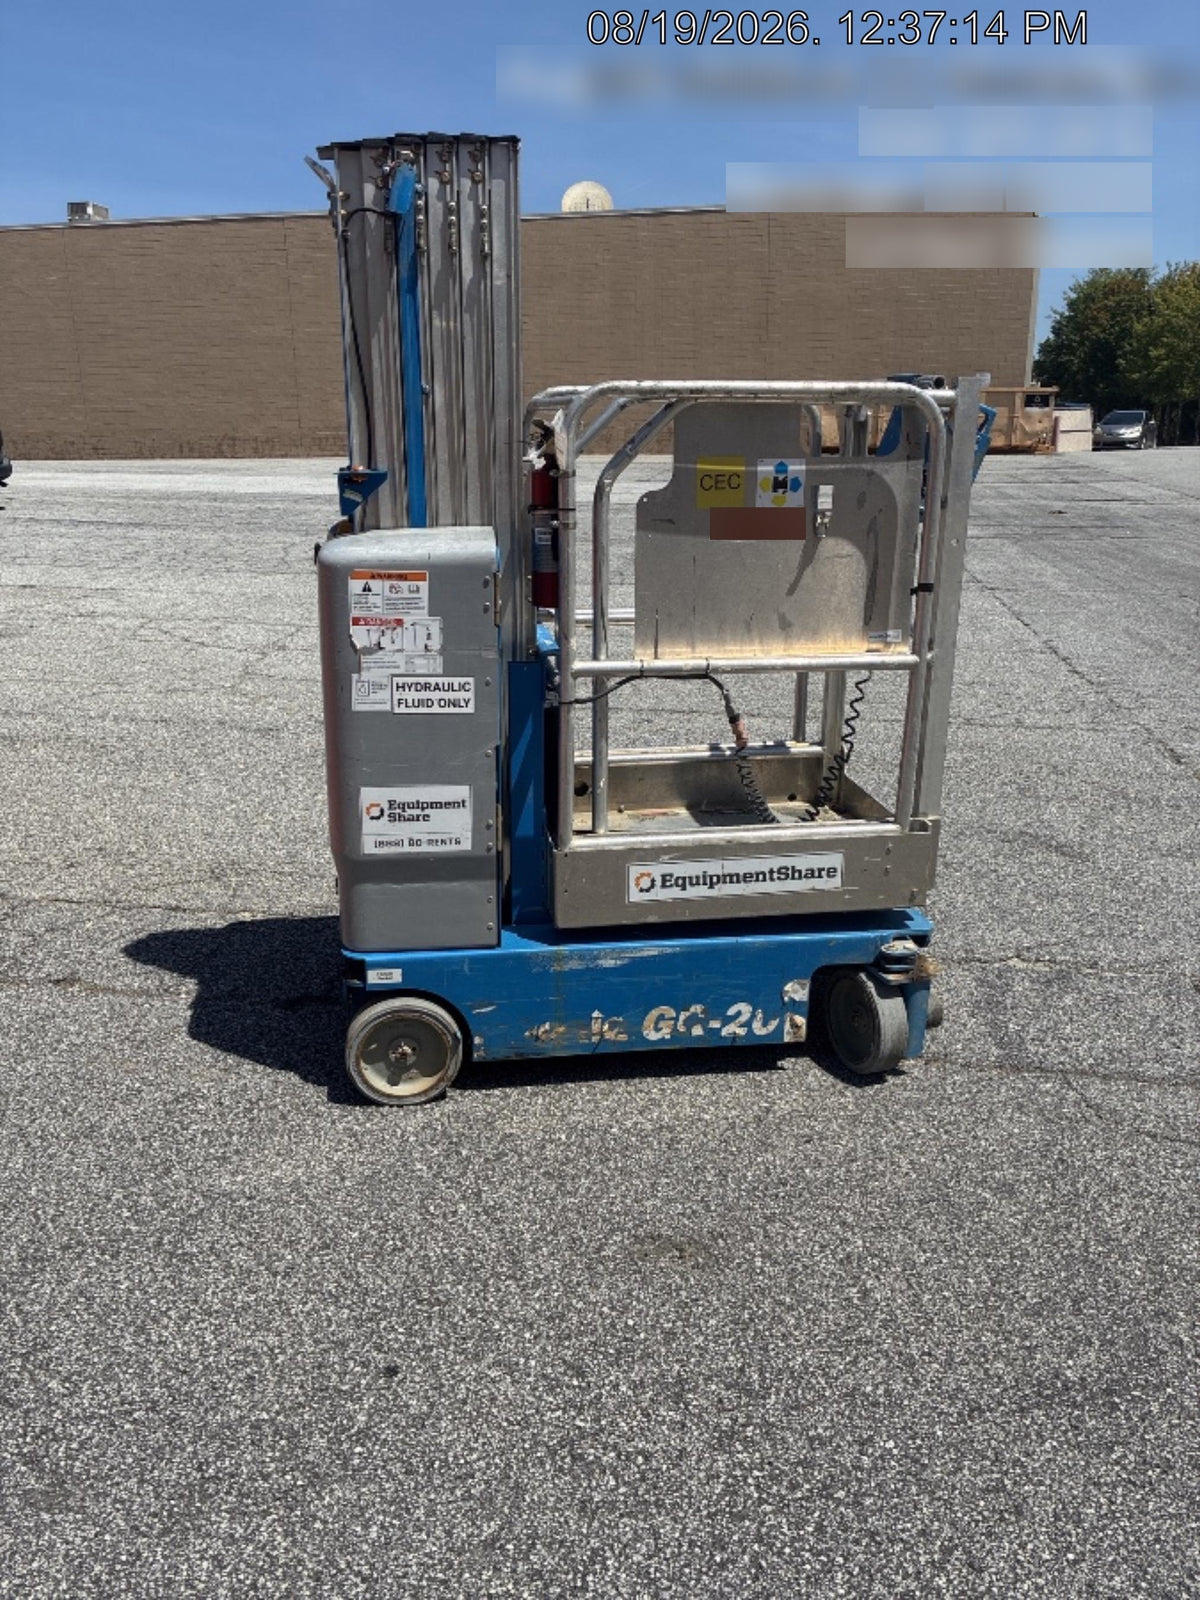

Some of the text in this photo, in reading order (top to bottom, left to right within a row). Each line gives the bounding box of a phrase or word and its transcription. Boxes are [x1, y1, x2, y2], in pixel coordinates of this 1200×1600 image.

[700, 473, 741, 491] CEC
[396, 681, 472, 693] HYDRAULIC
[398, 698, 434, 708] FLUID
[438, 698, 471, 708] ONLY
[387, 799, 466, 812] Equipment
[387, 812, 431, 822] Share
[660, 865, 837, 890] EquipmentShare
